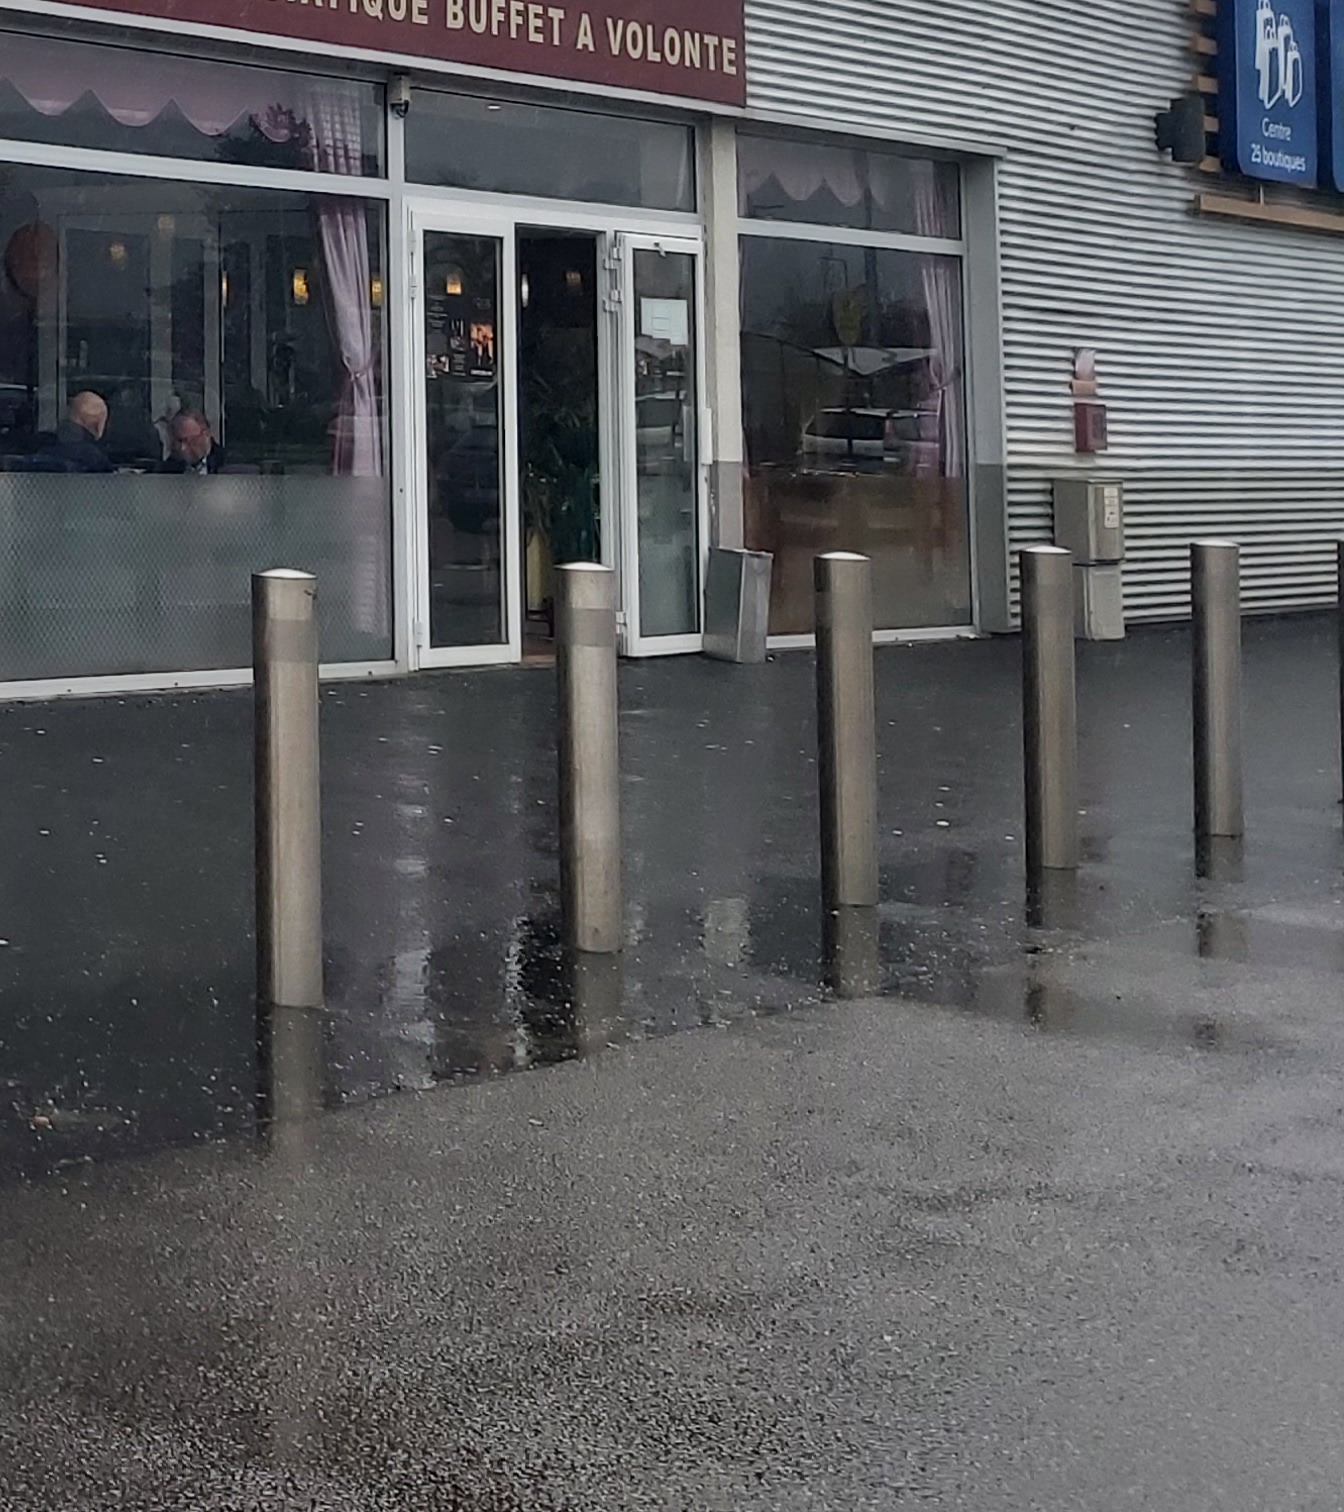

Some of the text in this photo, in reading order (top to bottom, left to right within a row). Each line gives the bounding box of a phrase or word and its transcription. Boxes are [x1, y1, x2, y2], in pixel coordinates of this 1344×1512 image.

[576, 13, 595, 52] A
[606, 17, 738, 76] VOLONTE
[1261, 117, 1291, 141] Centre
[1262, 145, 1306, 173] boutiques
